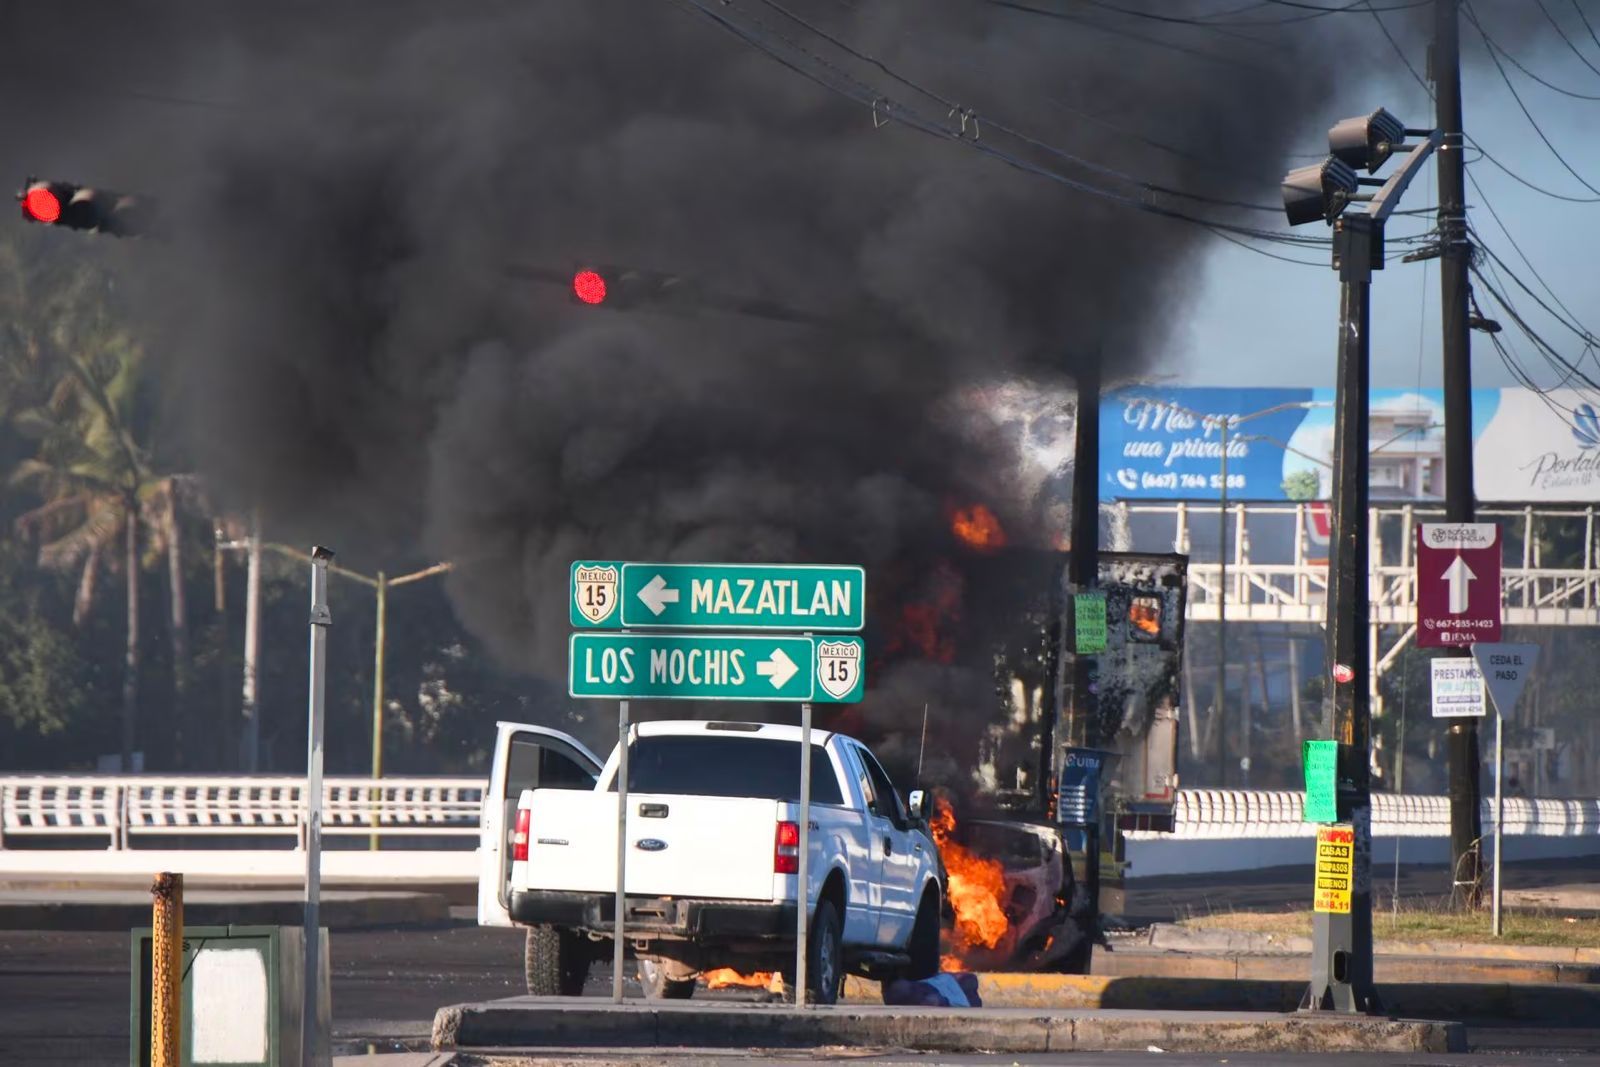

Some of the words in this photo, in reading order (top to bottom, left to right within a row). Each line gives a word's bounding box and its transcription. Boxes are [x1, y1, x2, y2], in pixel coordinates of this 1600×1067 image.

[1202, 413, 1241, 438] que
[1123, 441, 1163, 458] una
[1163, 433, 1249, 467] privada
[1518, 450, 1600, 487] Portal
[580, 571, 613, 581] MEXICO
[585, 584, 606, 606] 15
[691, 578, 851, 616] MAZATLAN
[592, 608, 599, 617] D
[822, 647, 855, 657] MEXICO
[1489, 655, 1511, 665] CEDA
[1513, 655, 1524, 665] EL
[585, 647, 635, 684] LOS
[650, 648, 746, 685] MOCHIS
[827, 660, 849, 682] 15
[1495, 670, 1518, 681] PASO
[1319, 829, 1354, 844] COMPRO
[1320, 846, 1348, 857] CASAS
